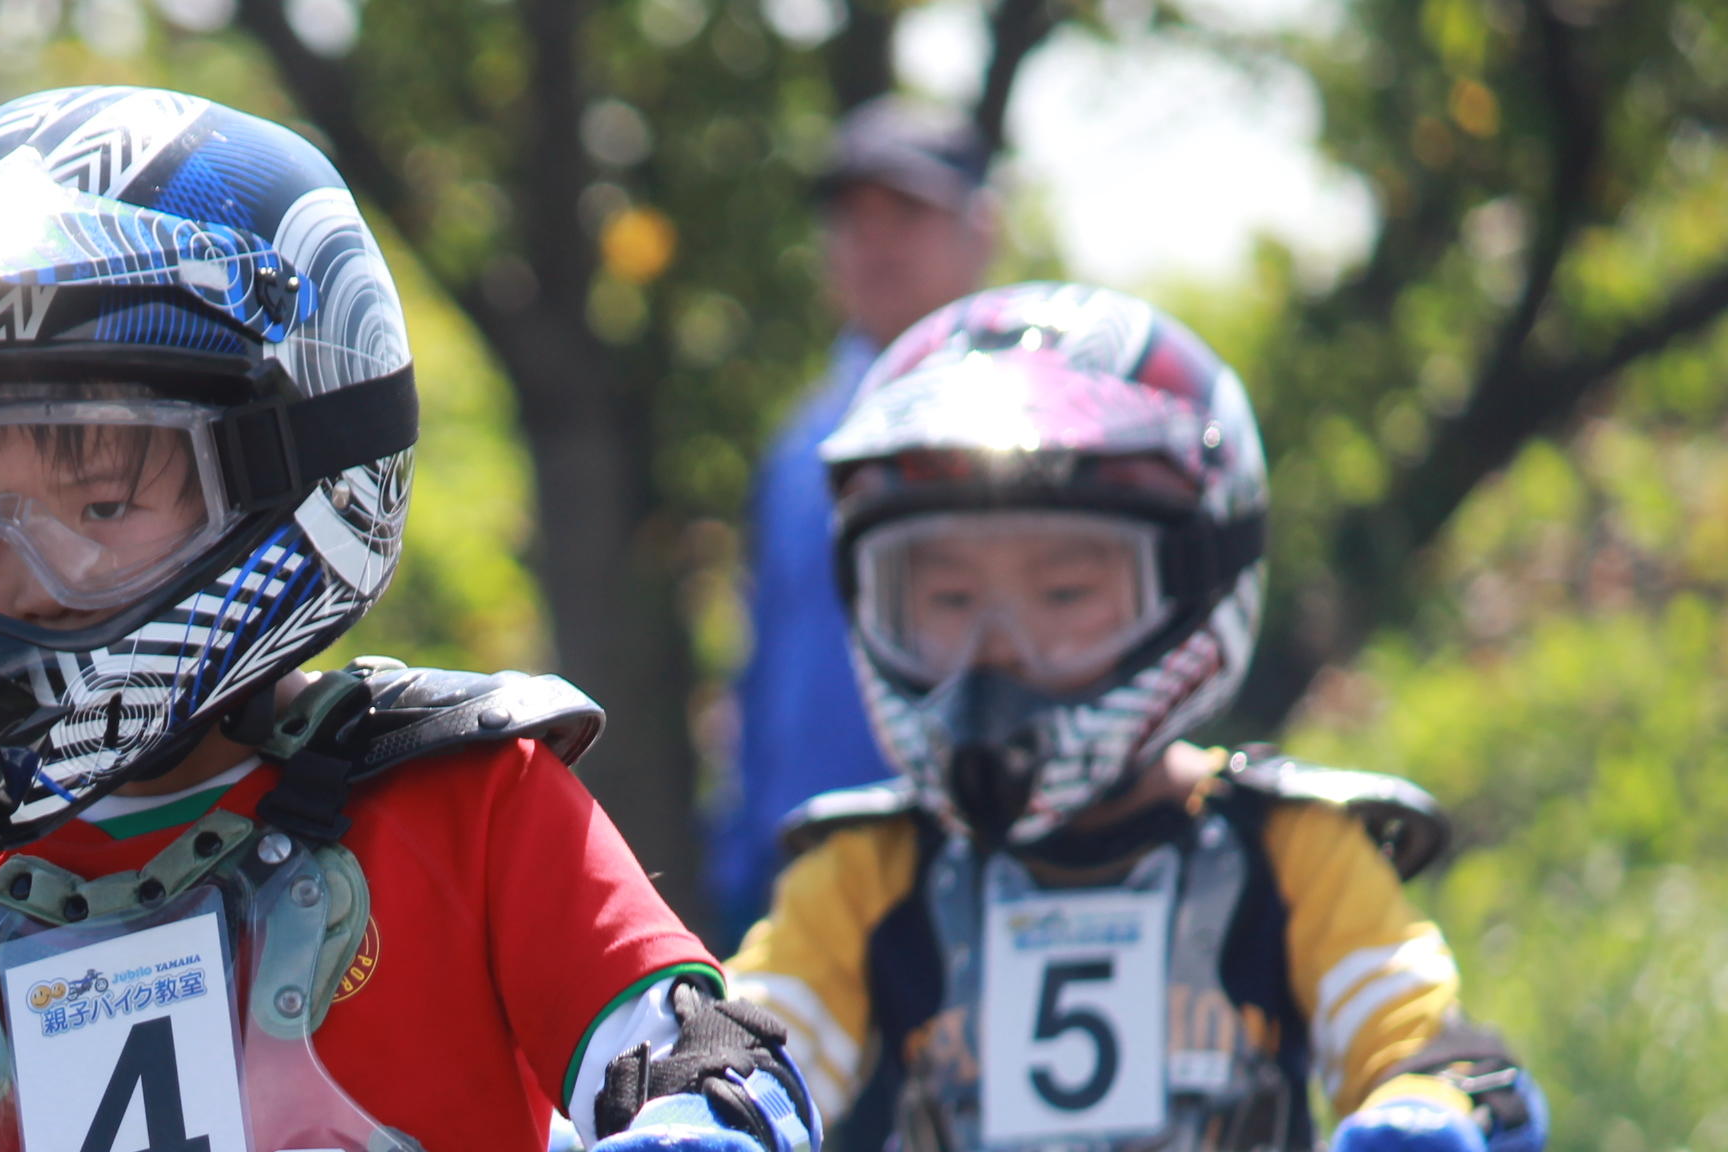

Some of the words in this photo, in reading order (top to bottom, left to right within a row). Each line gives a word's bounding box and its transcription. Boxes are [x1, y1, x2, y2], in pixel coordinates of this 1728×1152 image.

[154, 953, 201, 973] YAMAHA
[42, 970, 205, 1034] 親子バイク教室
[1029, 959, 1120, 1113] 5
